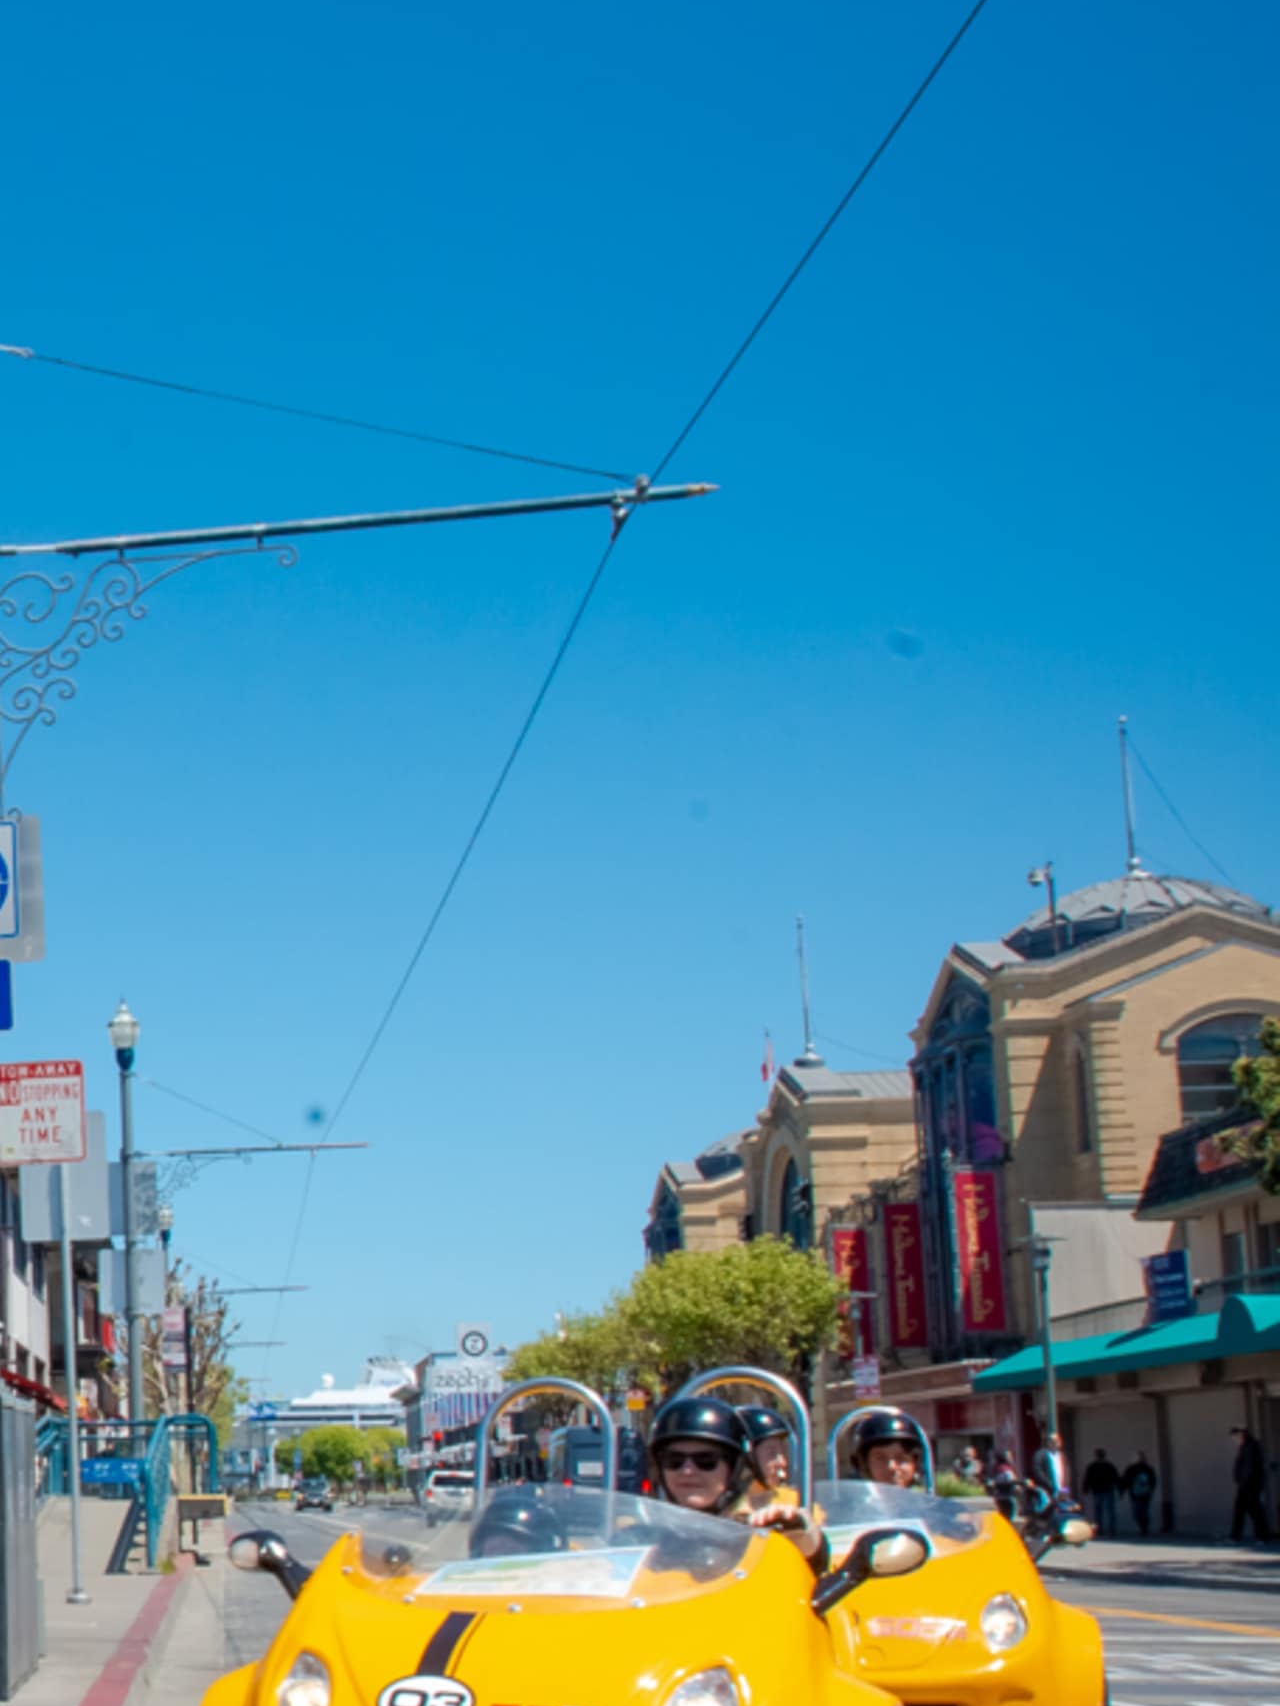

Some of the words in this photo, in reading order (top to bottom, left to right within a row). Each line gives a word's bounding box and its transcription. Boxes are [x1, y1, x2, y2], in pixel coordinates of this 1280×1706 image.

[0, 1063, 77, 1078] TOW-AWAY
[21, 1083, 81, 1101] STOPPING
[21, 1106, 58, 1124] ANY
[19, 1125, 64, 1145] TIME
